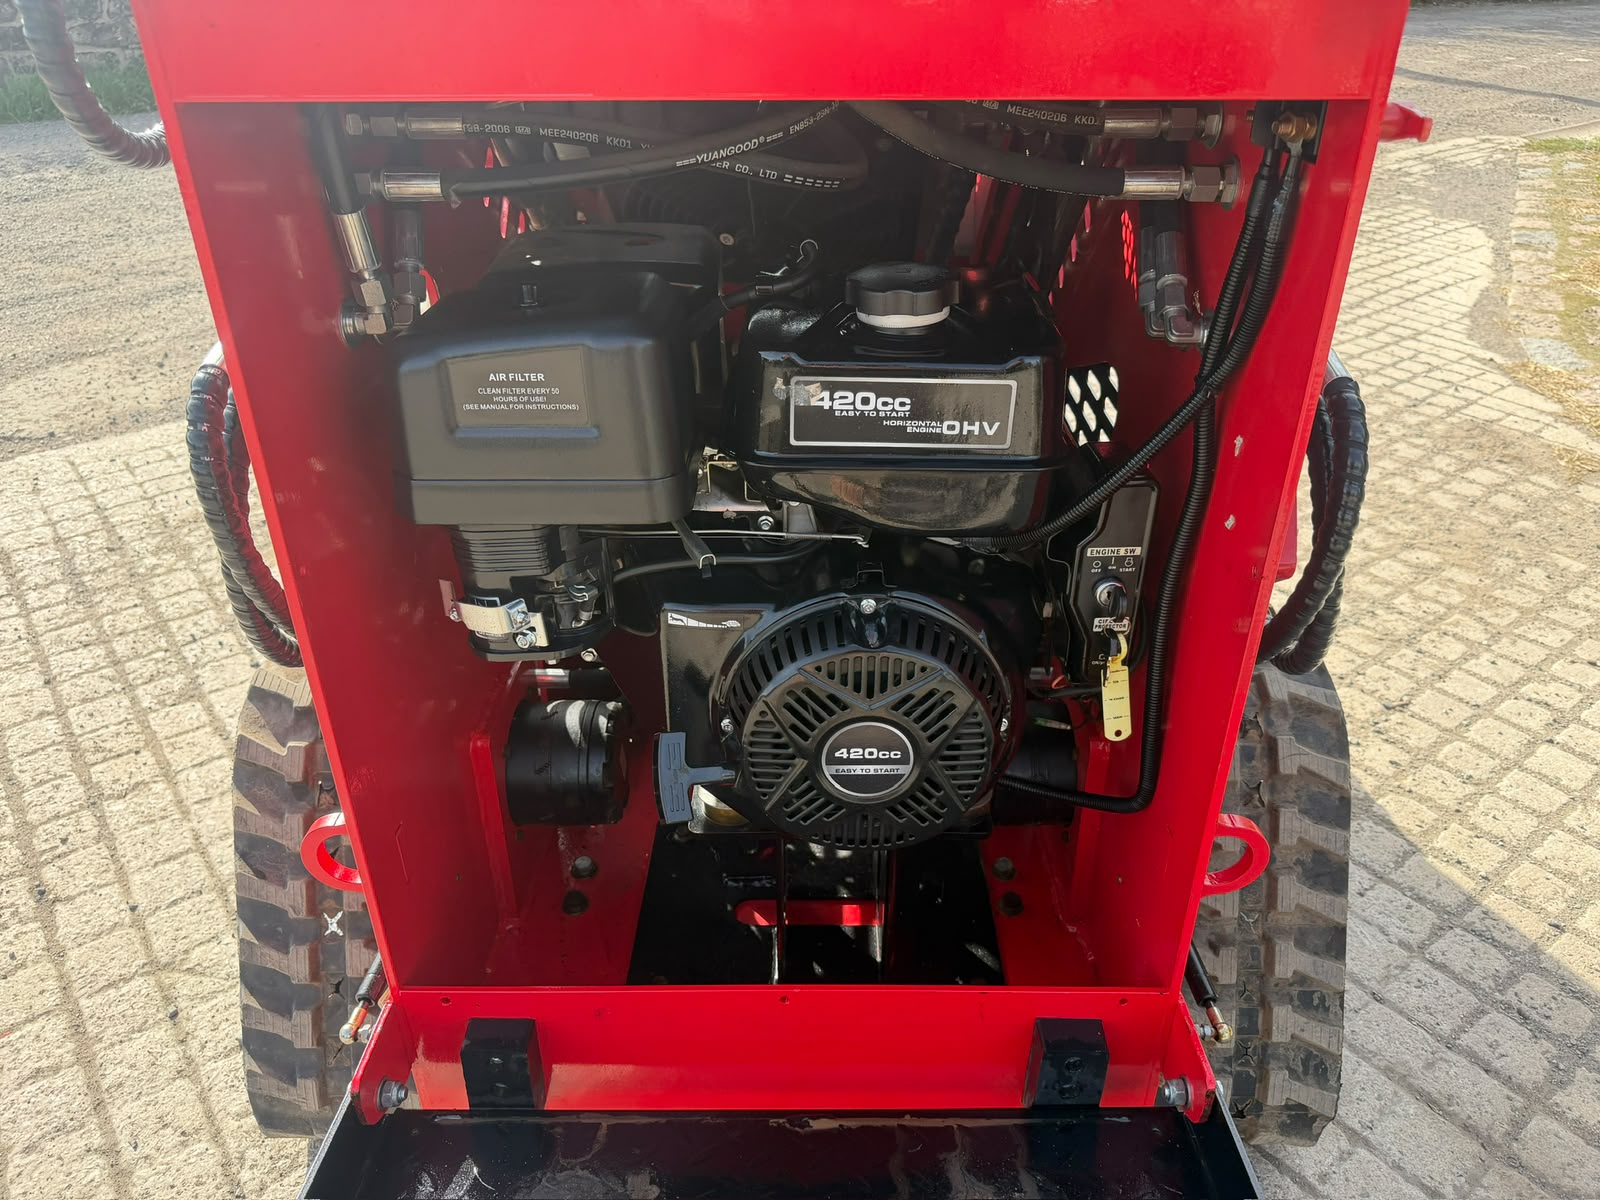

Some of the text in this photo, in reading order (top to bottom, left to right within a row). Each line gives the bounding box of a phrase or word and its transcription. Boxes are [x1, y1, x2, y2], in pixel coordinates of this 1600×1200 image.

[1006, 104, 1068, 122] MEE240206
[539, 127, 599, 143] MEE240206
[606, 135, 633, 149] KK01
[735, 163, 753, 176] CO.,
[759, 168, 778, 180] LTD
[489, 373, 545, 381] AIR FILTER
[477, 387, 560, 395] CLEAN FILTER EVERY 50
[812, 390, 911, 411] 420cc
[462, 403, 580, 411] (SEE MANUAL FOR INSTRUCTIONS)
[863, 410, 877, 418] TO
[883, 420, 943, 428] HORIZONTAL
[906, 426, 942, 434] ENGINE
[942, 421, 1001, 436] OHV
[1090, 548, 1121, 556] ENGINE
[834, 748, 902, 759] 420cc
